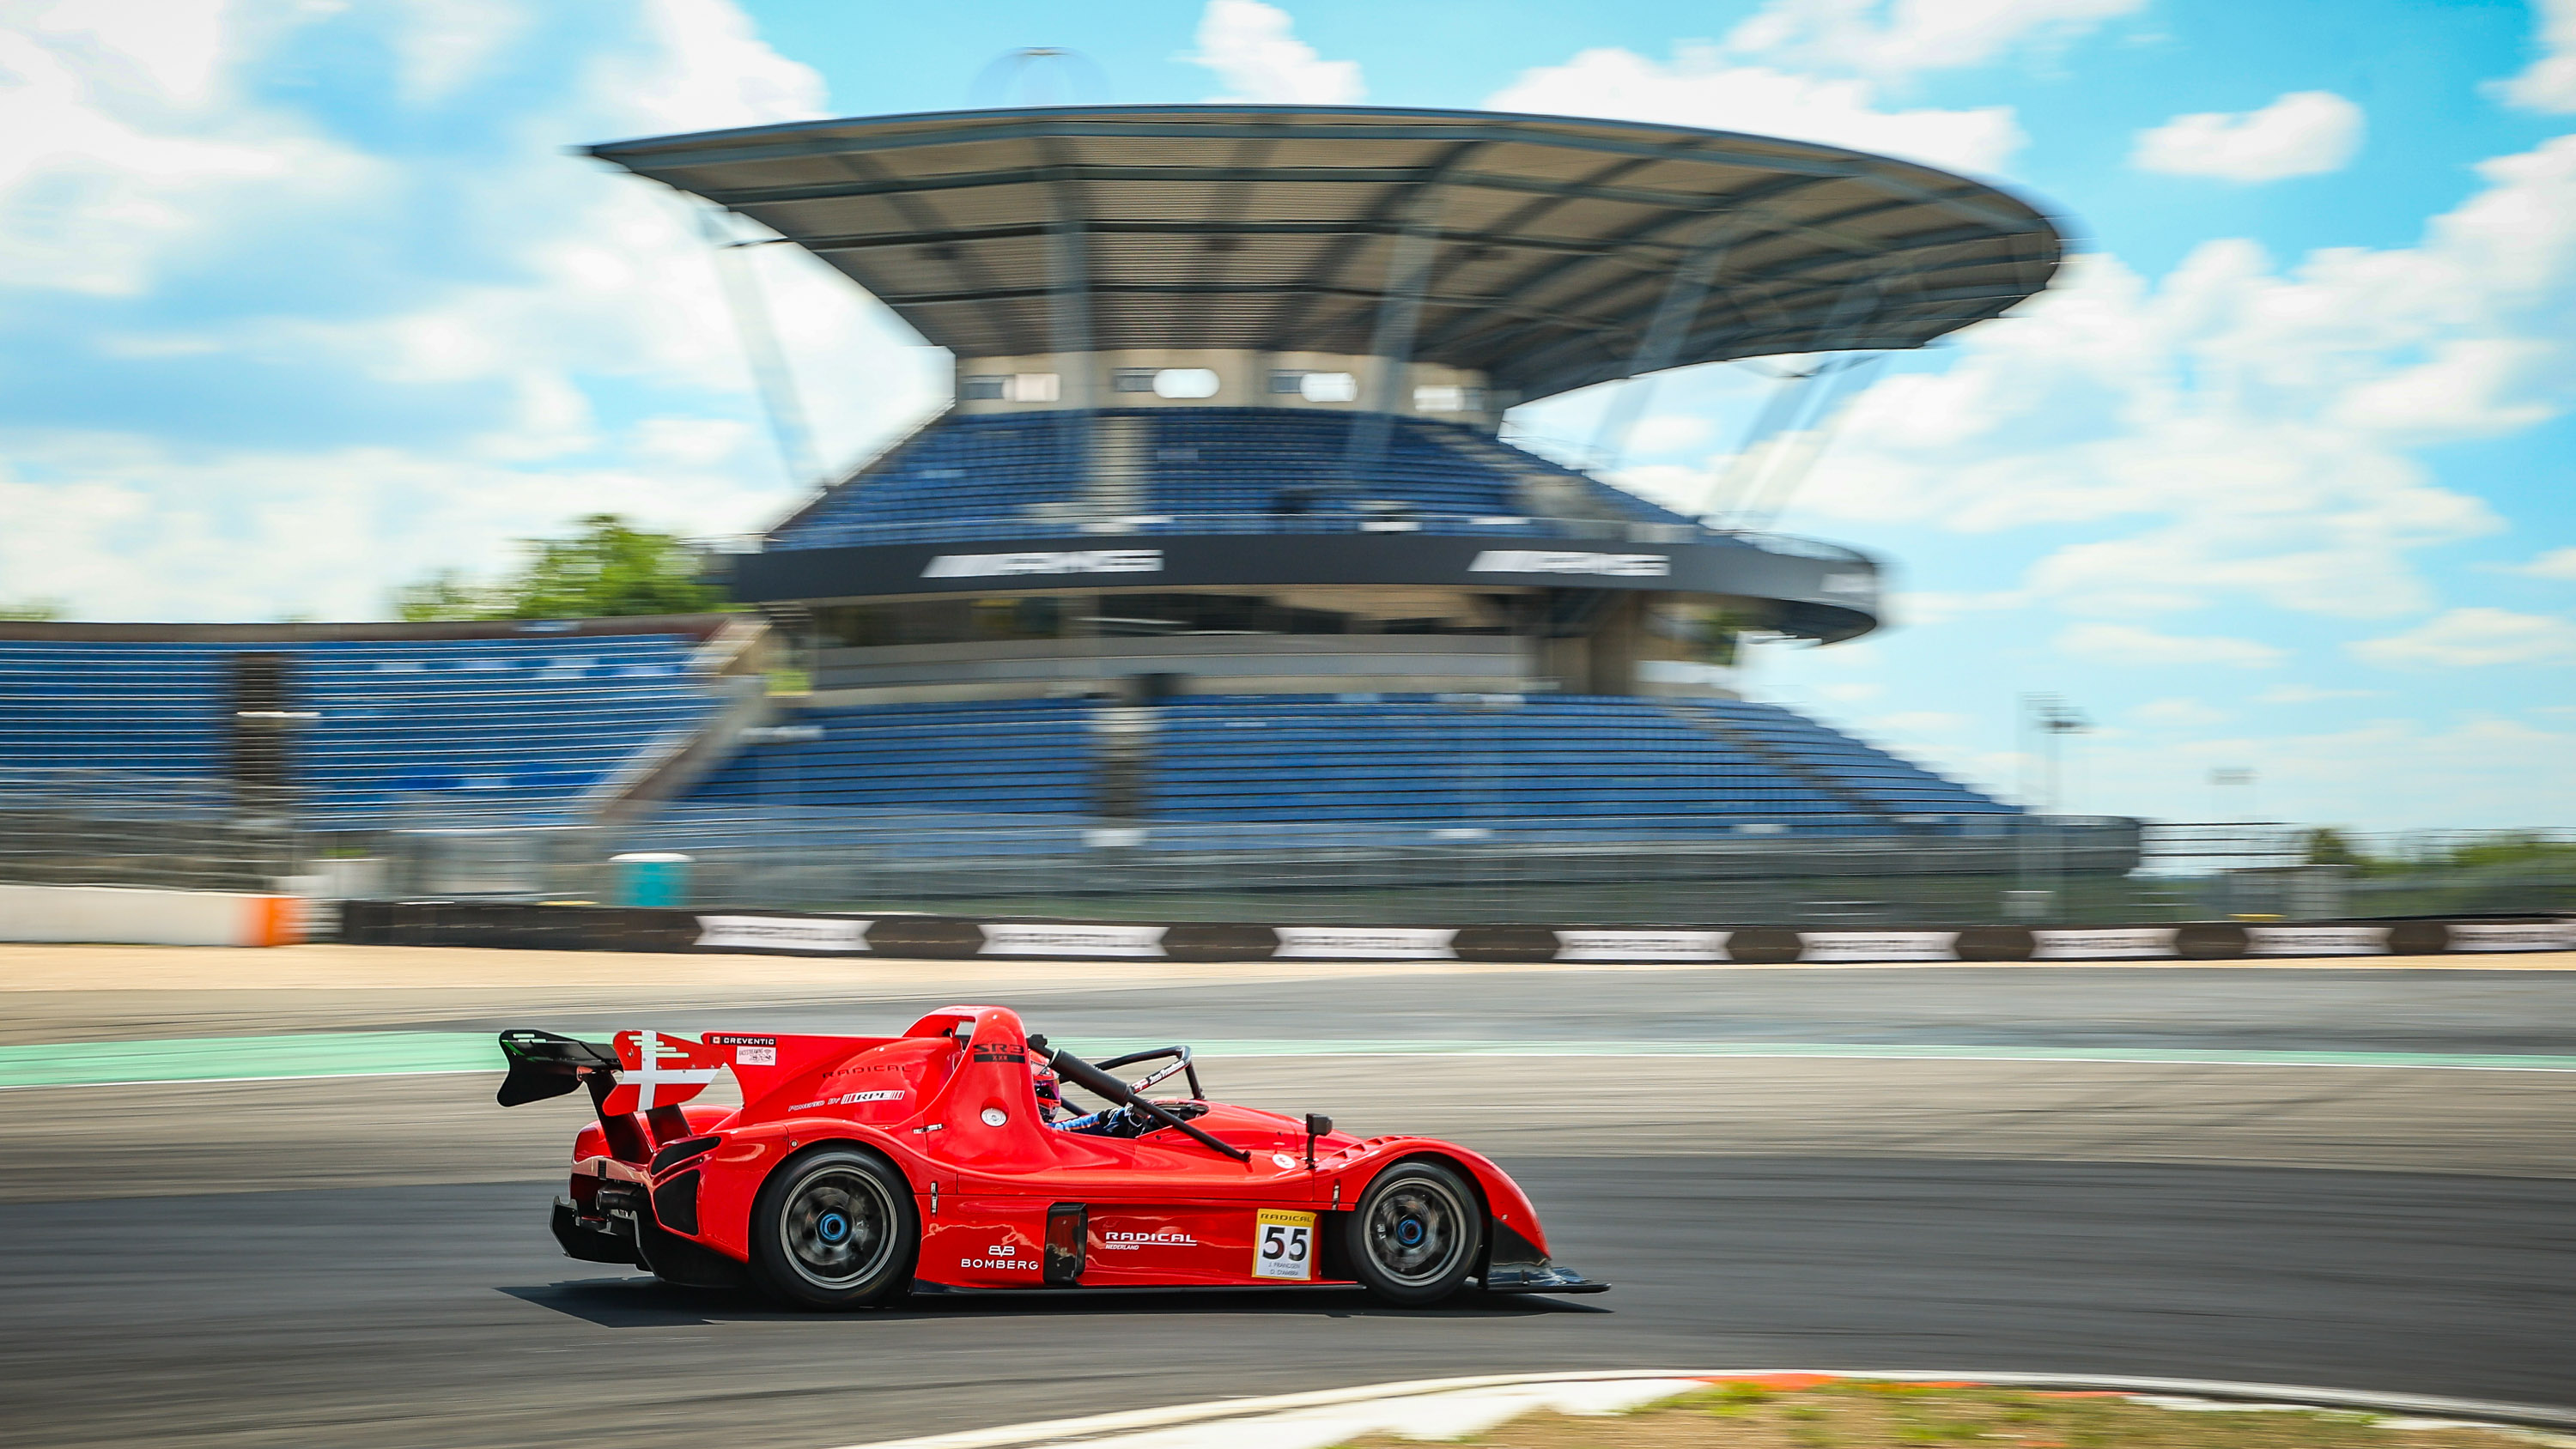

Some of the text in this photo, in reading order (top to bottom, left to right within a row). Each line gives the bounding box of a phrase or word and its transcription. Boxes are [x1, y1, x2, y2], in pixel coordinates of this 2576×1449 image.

[724, 1037, 775, 1046] CREVENTIC
[973, 1044, 1024, 1054] SR3
[823, 1064, 912, 1079] RADICAL
[788, 1100, 825, 1112] POWERED
[856, 1092, 890, 1100] RPE
[1261, 1213, 1313, 1222] RADICAL
[1105, 1232, 1198, 1243] RADICAL
[1262, 1226, 1308, 1262] 55
[961, 1258, 1039, 1270] BOMBERG
